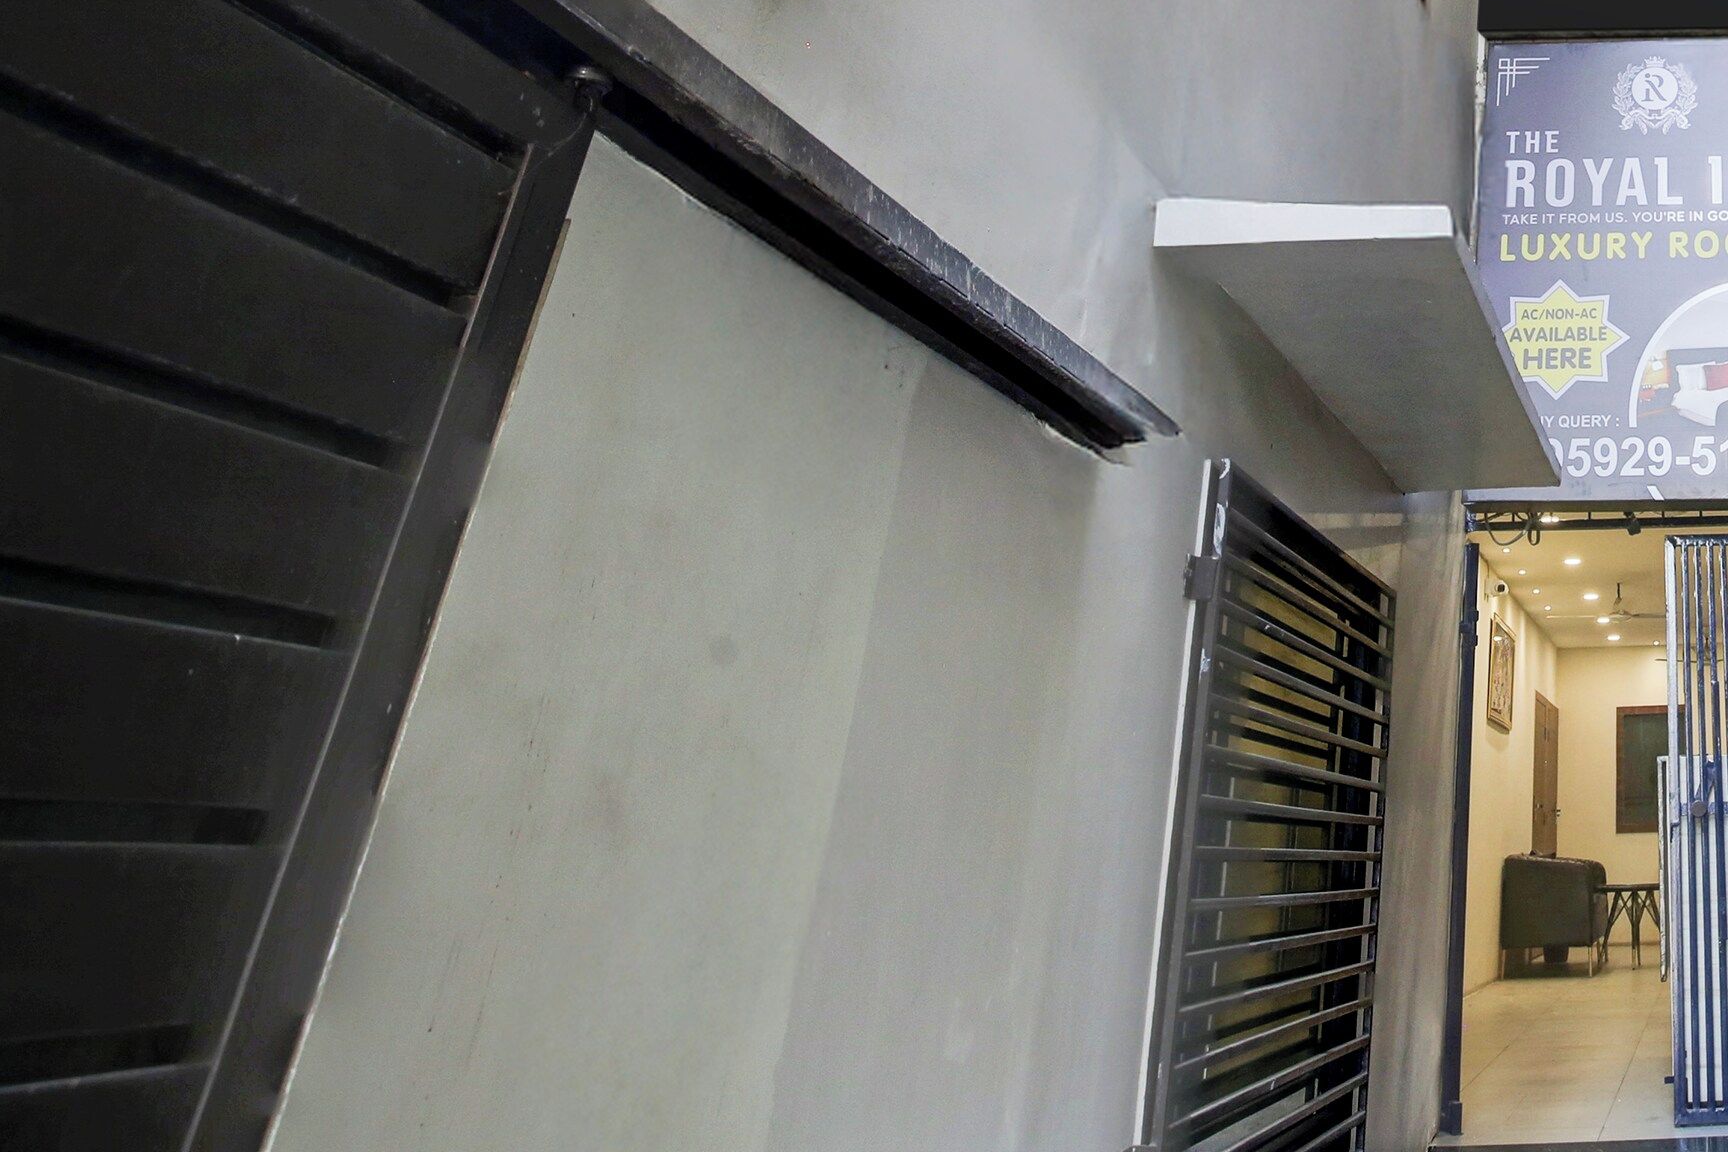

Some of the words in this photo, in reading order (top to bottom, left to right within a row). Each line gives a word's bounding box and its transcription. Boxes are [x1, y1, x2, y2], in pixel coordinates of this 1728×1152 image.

[1506, 131, 1560, 154] THE
[1505, 157, 1684, 208] ROYAL
[1502, 214, 1538, 225] TAKE
[1542, 214, 1555, 224] IT
[1559, 213, 1600, 223] FROM
[1605, 212, 1628, 223] US.
[1632, 210, 1685, 222] YOU'RE
[1689, 211, 1703, 221] IN
[1500, 231, 1653, 262] LUXURY
[1521, 308, 1597, 320] AC/NON-AC
[1509, 327, 1607, 342] AVAILABLE
[1522, 348, 1592, 369] HERE
[1558, 415, 1611, 428] QUERY
